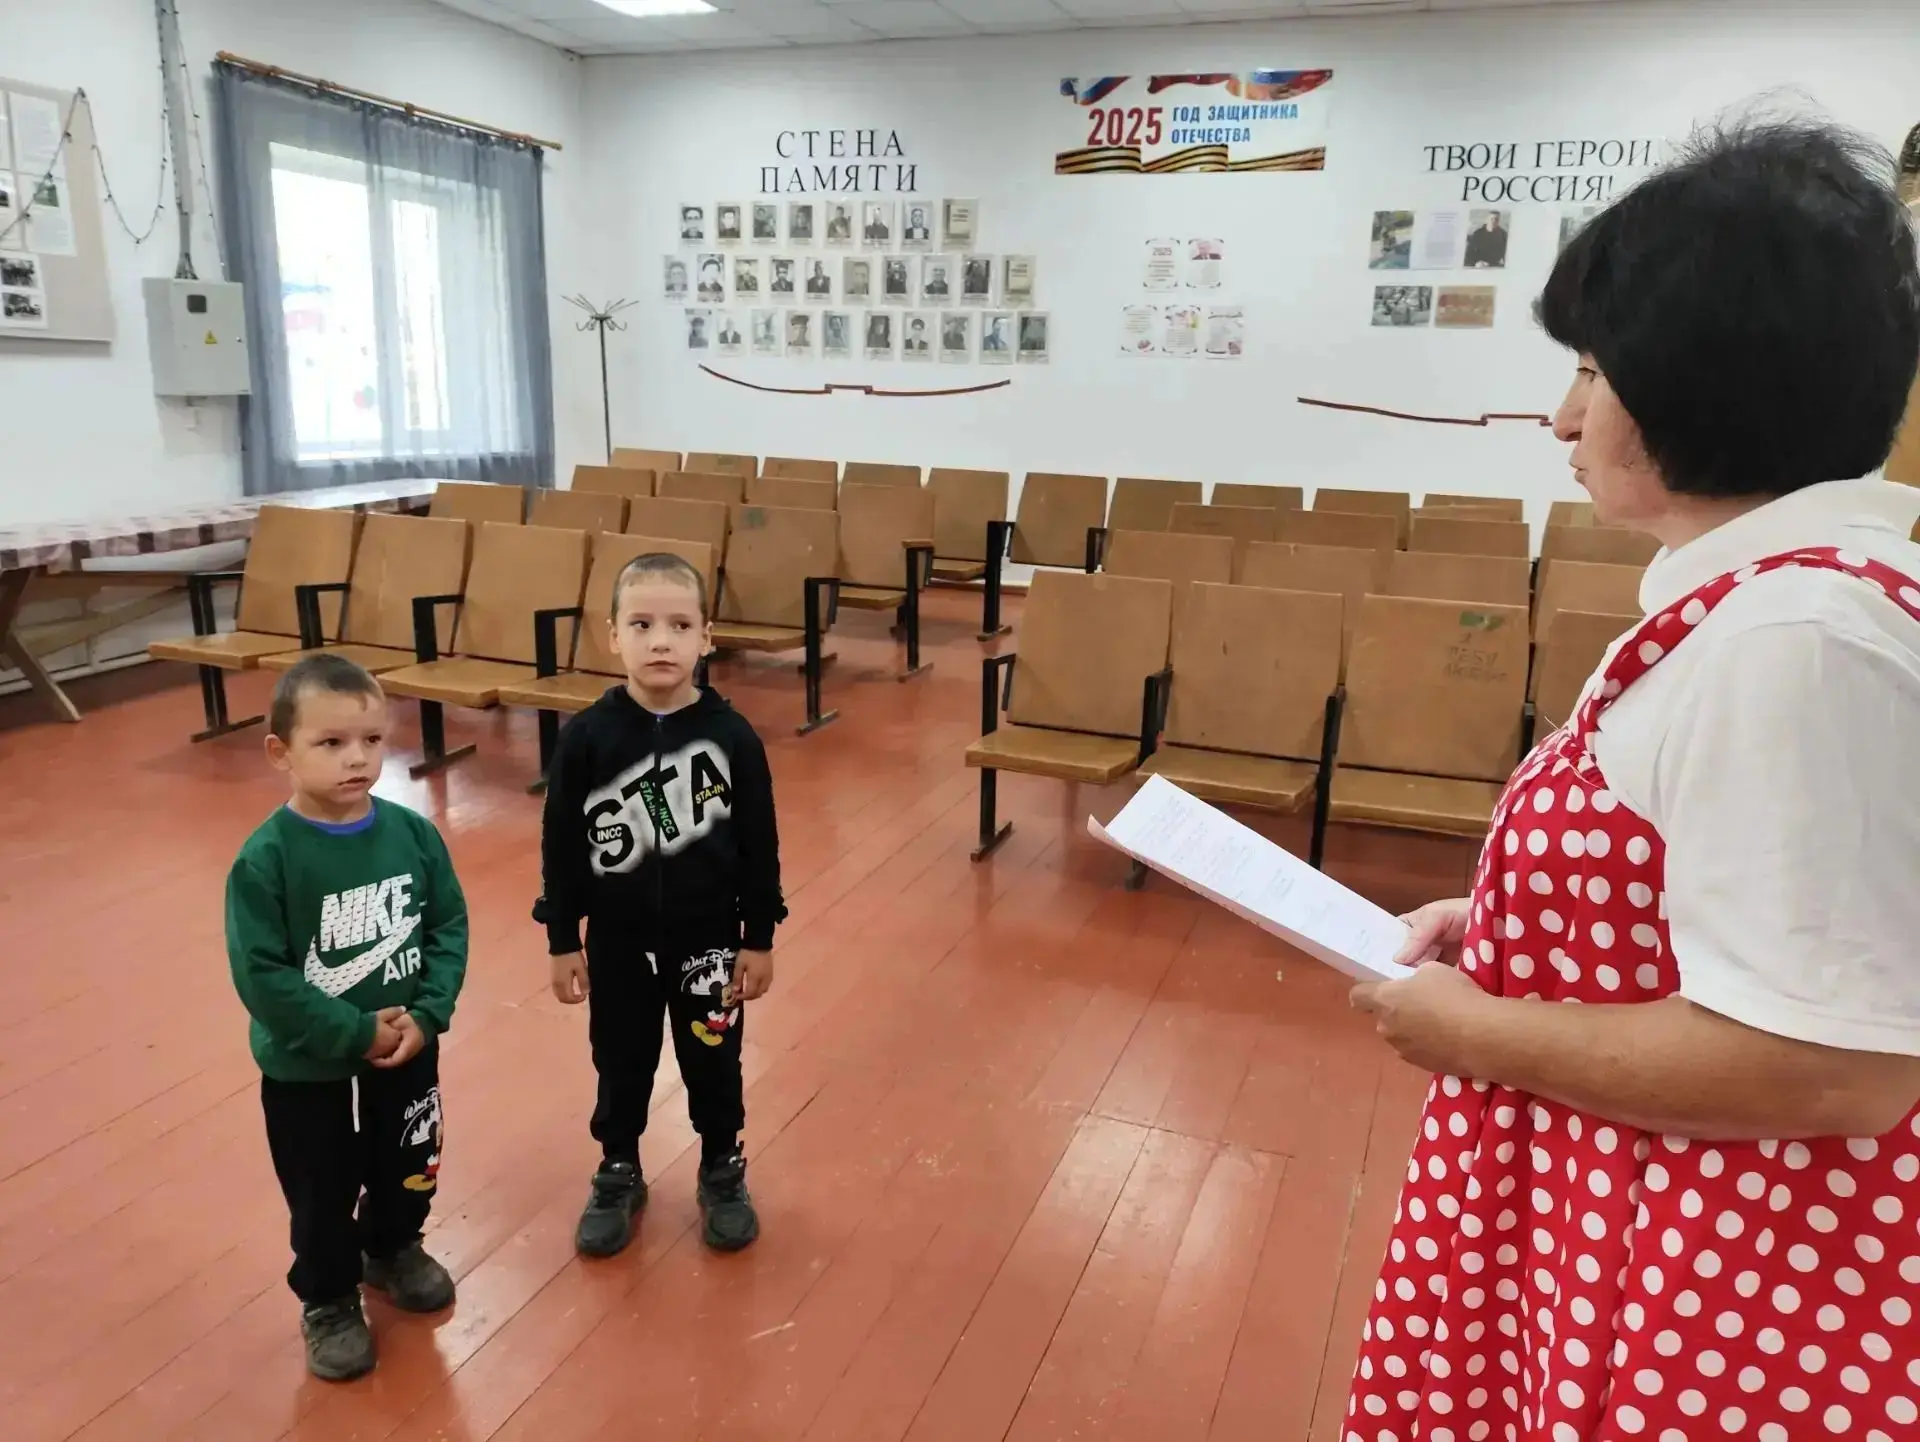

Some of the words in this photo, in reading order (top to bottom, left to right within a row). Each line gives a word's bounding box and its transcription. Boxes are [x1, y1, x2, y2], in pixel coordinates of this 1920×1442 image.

[1087, 107, 1163, 146] 2025
[1172, 106, 1200, 123] ГОД
[1208, 103, 1298, 121] ЗАЩИТНИКА
[776, 129, 905, 159] СТЕНА
[1171, 127, 1251, 144] ОТЕЧЕСТВА
[1423, 142, 1519, 172] ТВОИ
[759, 164, 918, 194] ПАМЯТИ
[1461, 175, 1614, 203] РОССИЯ!
[695, 783, 725, 804] STA-IN
[597, 826, 623, 842] INCC
[320, 873, 413, 952] NIKE
[382, 946, 421, 986] AIR
